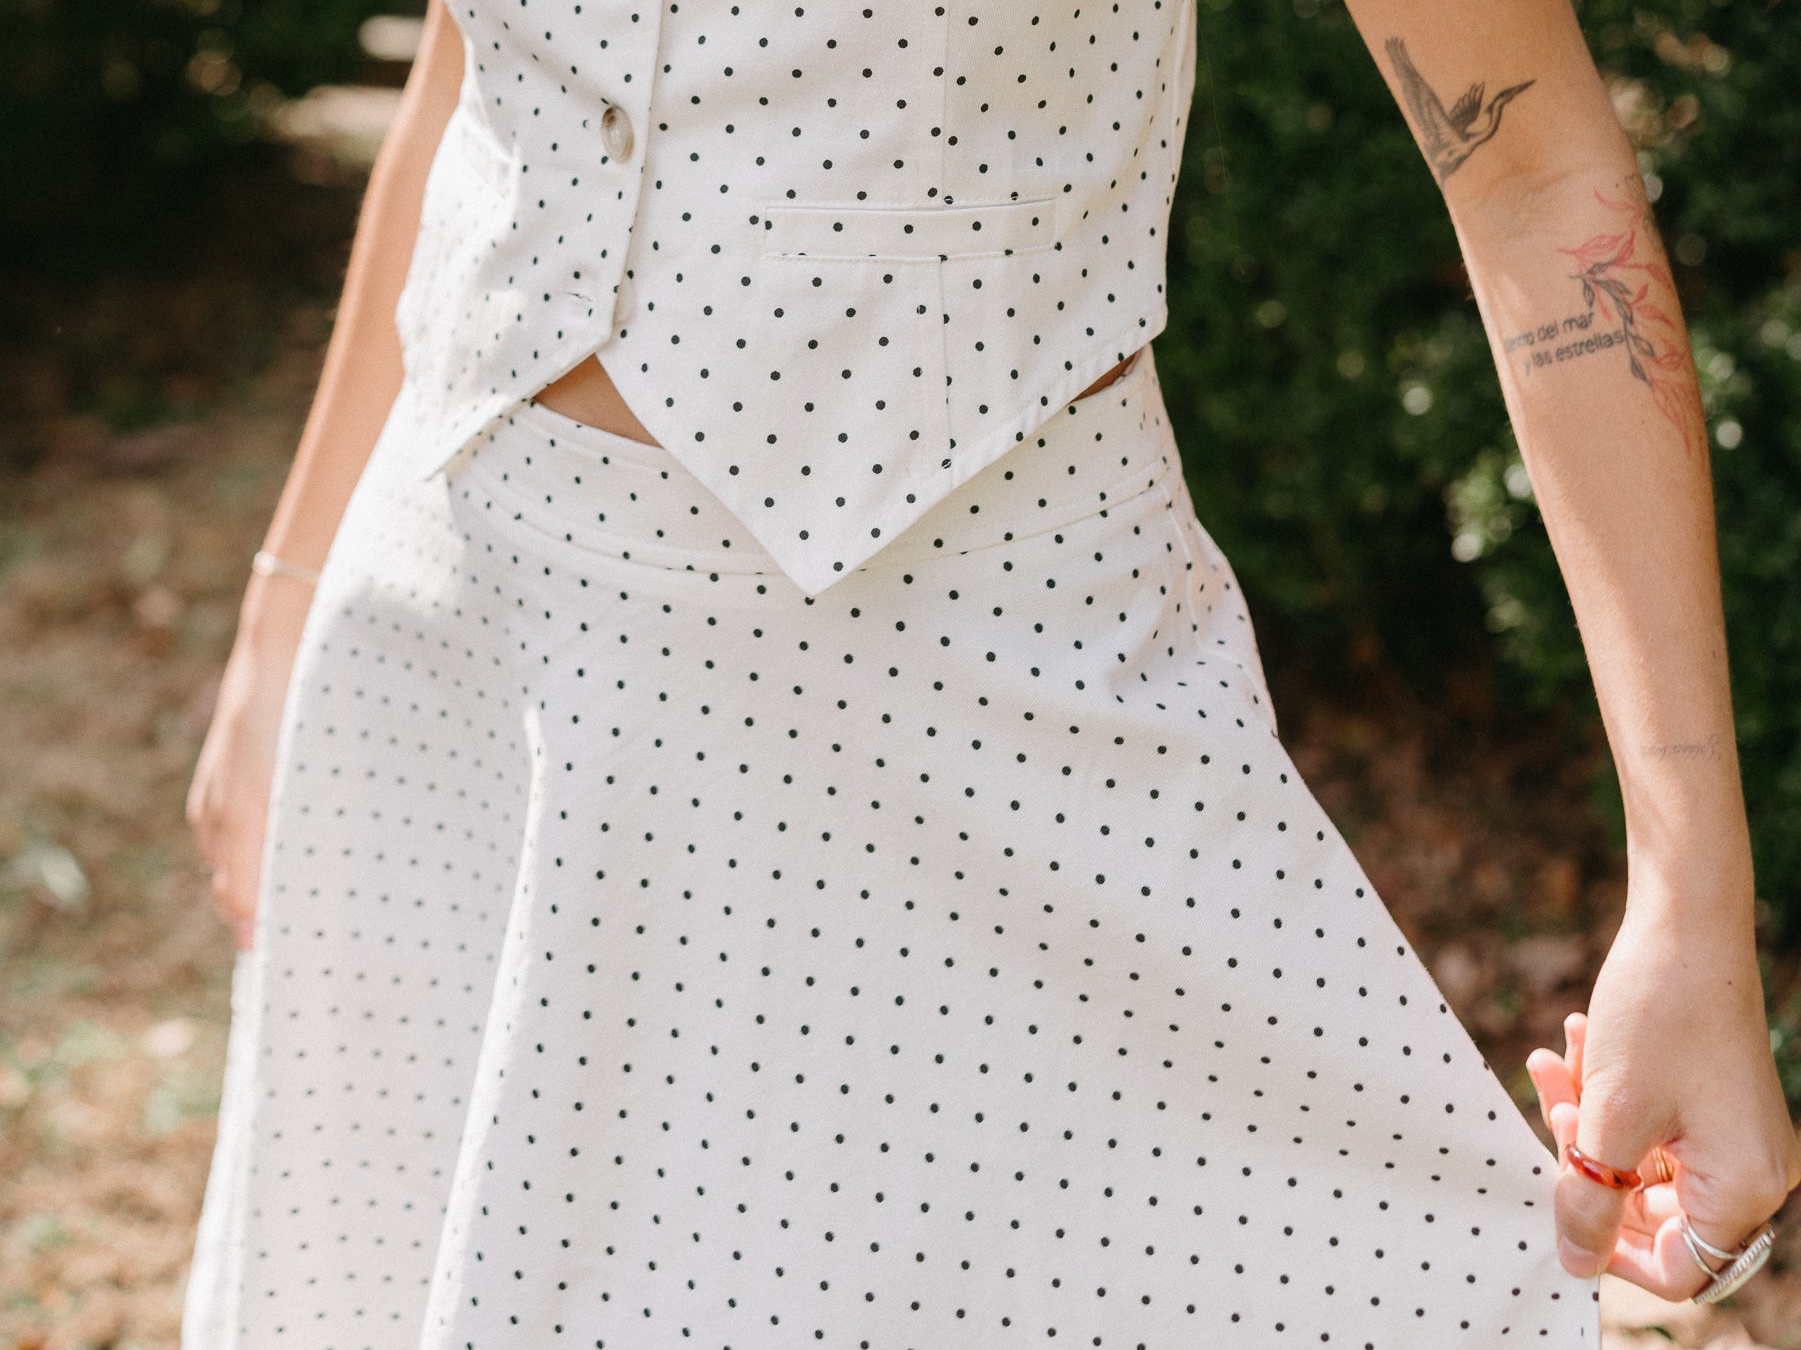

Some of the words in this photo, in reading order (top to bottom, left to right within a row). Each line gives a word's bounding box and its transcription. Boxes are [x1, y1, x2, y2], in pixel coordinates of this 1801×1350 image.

[1537, 321, 1559, 342] del
[1562, 311, 1595, 333] mar
[1531, 351, 1553, 368] las
[1555, 328, 1625, 362] estrellas
